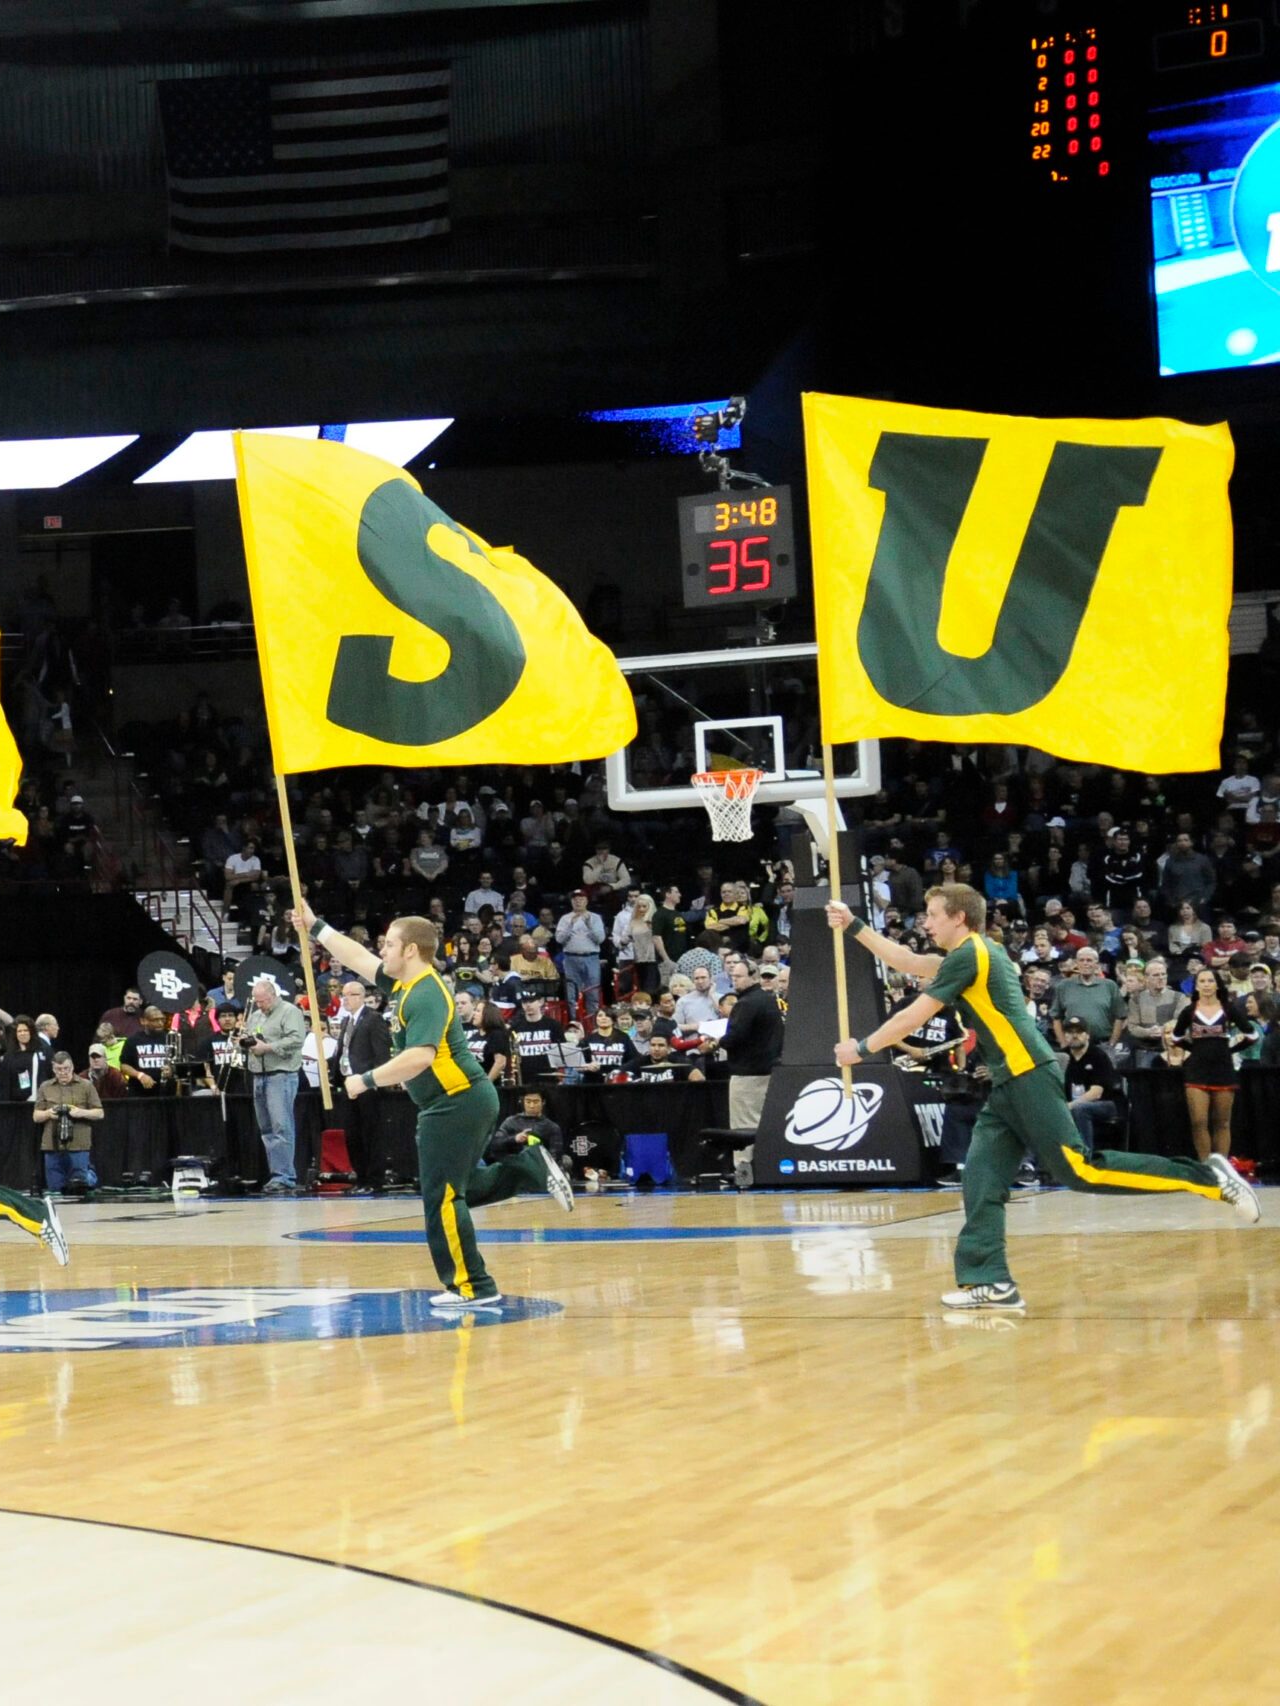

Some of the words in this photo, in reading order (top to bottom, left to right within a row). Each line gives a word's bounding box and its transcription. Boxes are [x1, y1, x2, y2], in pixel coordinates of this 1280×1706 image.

[1210, 30, 1227, 57] 0
[1038, 76, 1048, 91] 2
[1034, 99, 1049, 113] 13
[1031, 121, 1050, 136] 20
[1031, 144, 1051, 159] 22
[715, 497, 777, 531] 3:48
[707, 536, 771, 595] 35
[857, 431, 1165, 717] U
[326, 478, 526, 747] S
[517, 1031, 532, 1042] WE
[533, 1029, 551, 1041] ARE
[136, 1044, 154, 1055] WE
[588, 1042, 606, 1052] WE
[138, 1057, 169, 1069] AZTEC
[797, 1159, 896, 1173] BASKETBALL
